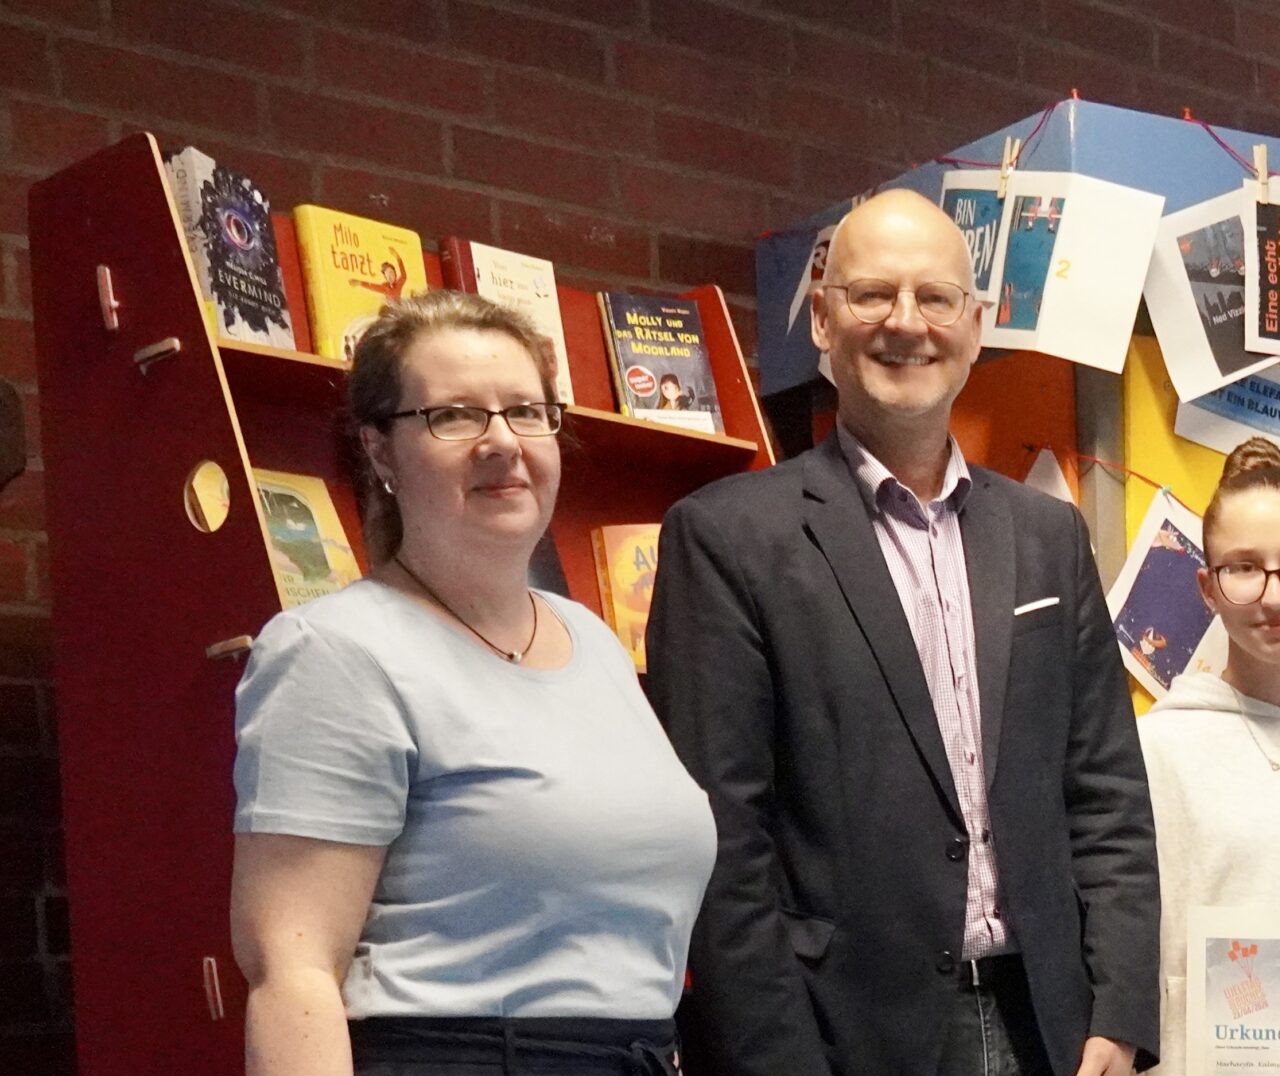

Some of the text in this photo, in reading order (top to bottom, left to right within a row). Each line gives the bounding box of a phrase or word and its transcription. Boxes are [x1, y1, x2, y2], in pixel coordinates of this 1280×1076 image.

[955, 198, 976, 227] BIN
[333, 223, 360, 248] Milo
[961, 219, 997, 279] REN
[331, 244, 377, 277] tanzt
[1054, 258, 1072, 280] 2
[218, 270, 281, 308] EVERMIND
[1265, 239, 1279, 333] Eine echt
[625, 312, 662, 327] MOLLY
[630, 341, 692, 358] MOORLAND
